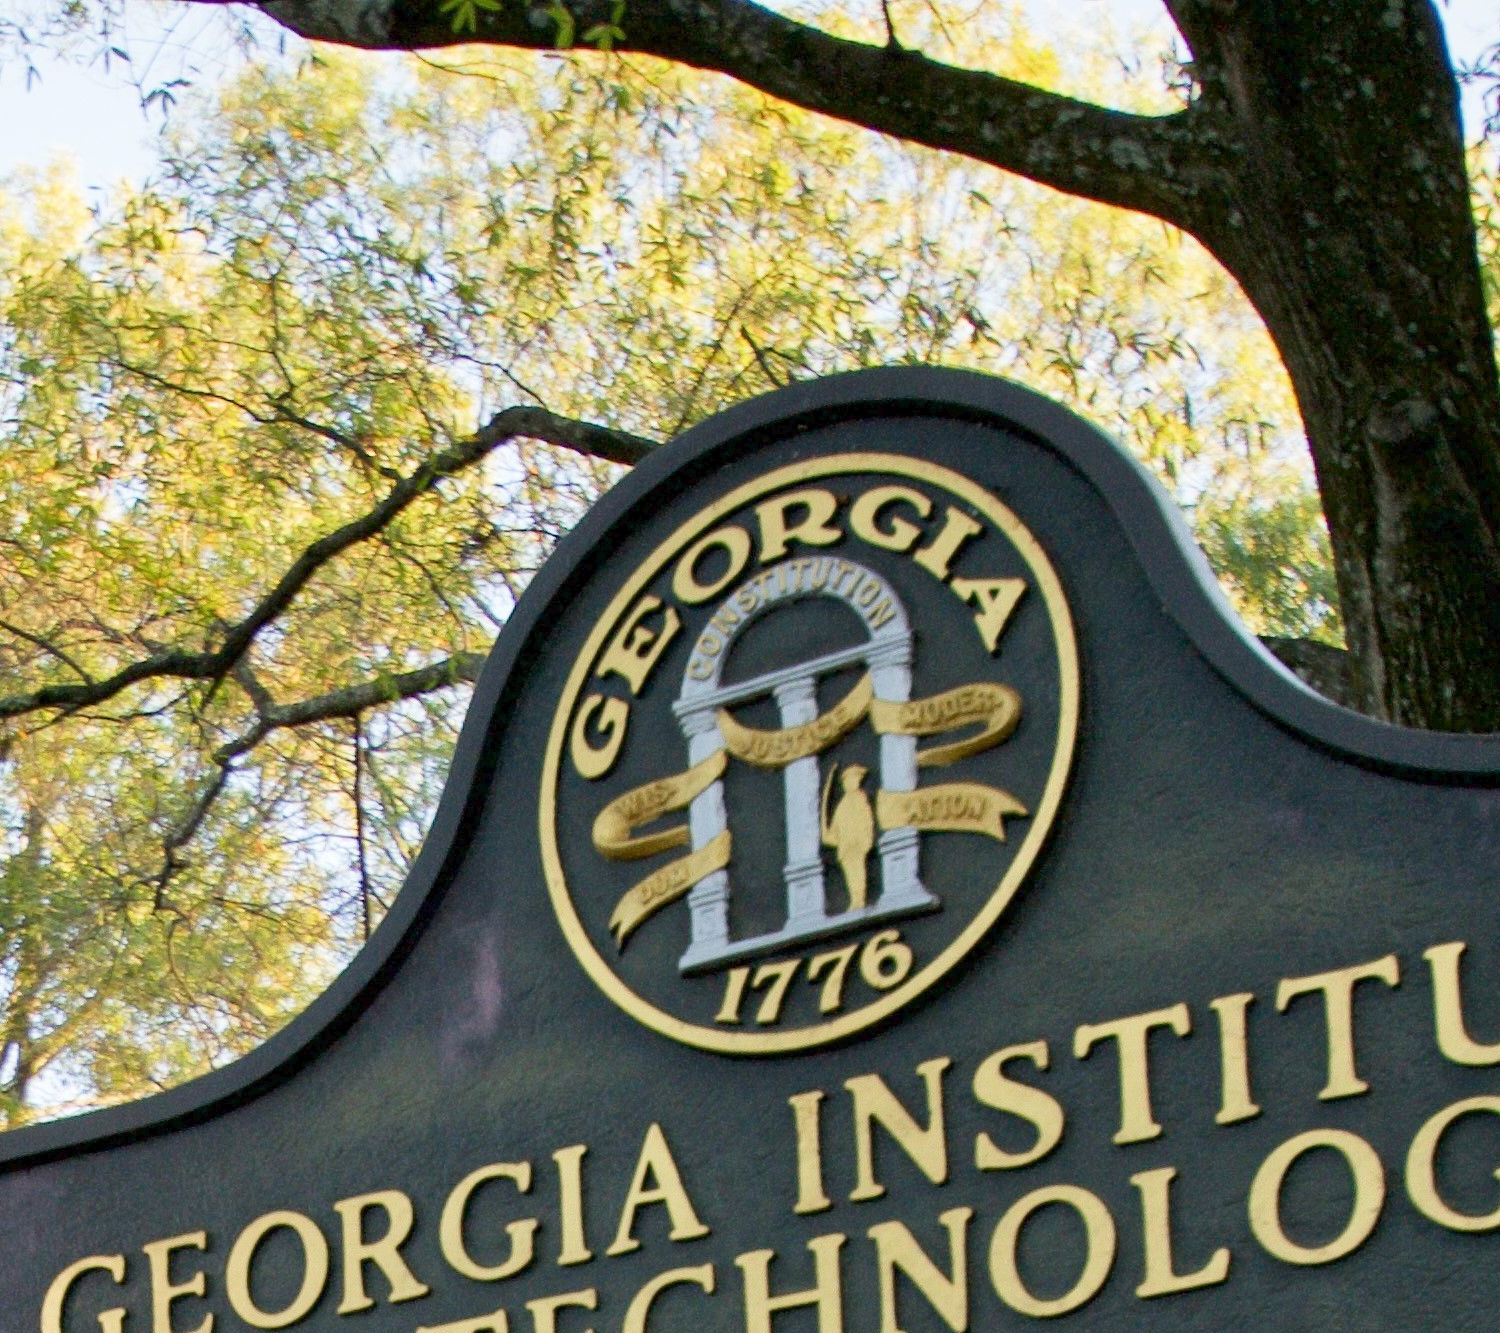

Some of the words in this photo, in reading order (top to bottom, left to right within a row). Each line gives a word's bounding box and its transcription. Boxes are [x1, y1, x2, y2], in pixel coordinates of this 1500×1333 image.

[569, 484, 1028, 779] GEORGIA
[684, 556, 898, 682] CONSTITUTION
[714, 928, 914, 1025] 1776
